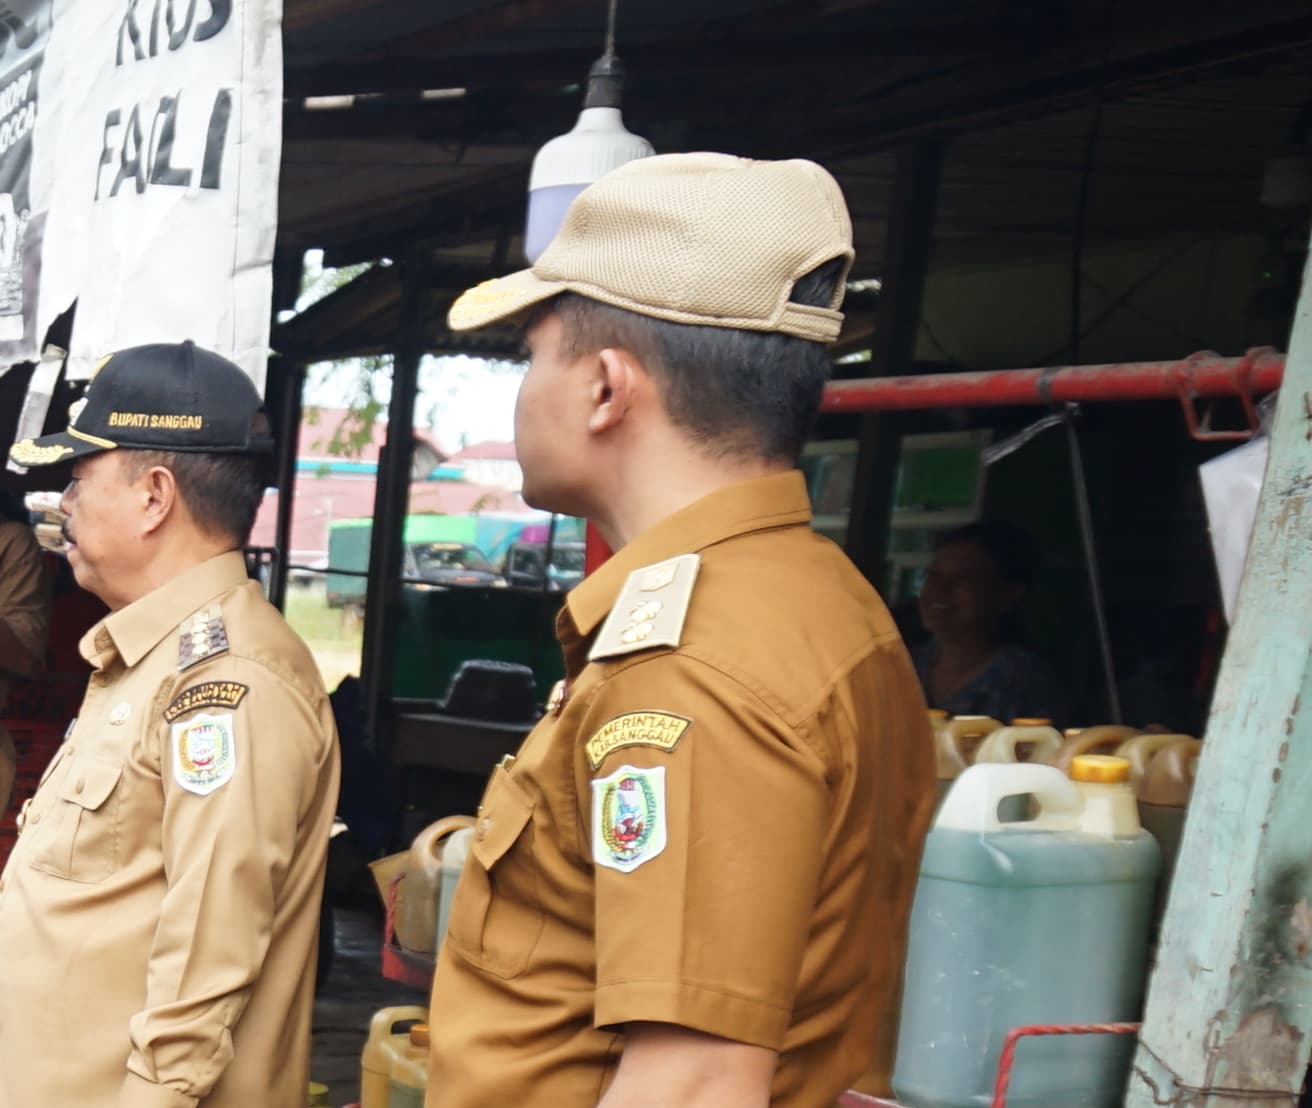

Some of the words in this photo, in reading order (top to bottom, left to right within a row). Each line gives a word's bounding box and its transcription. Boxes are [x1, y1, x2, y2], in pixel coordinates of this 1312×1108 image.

[108, 411, 149, 427] BUPATI
[150, 414, 203, 430] SANGGAU
[592, 715, 680, 749] PEMERINTAH
